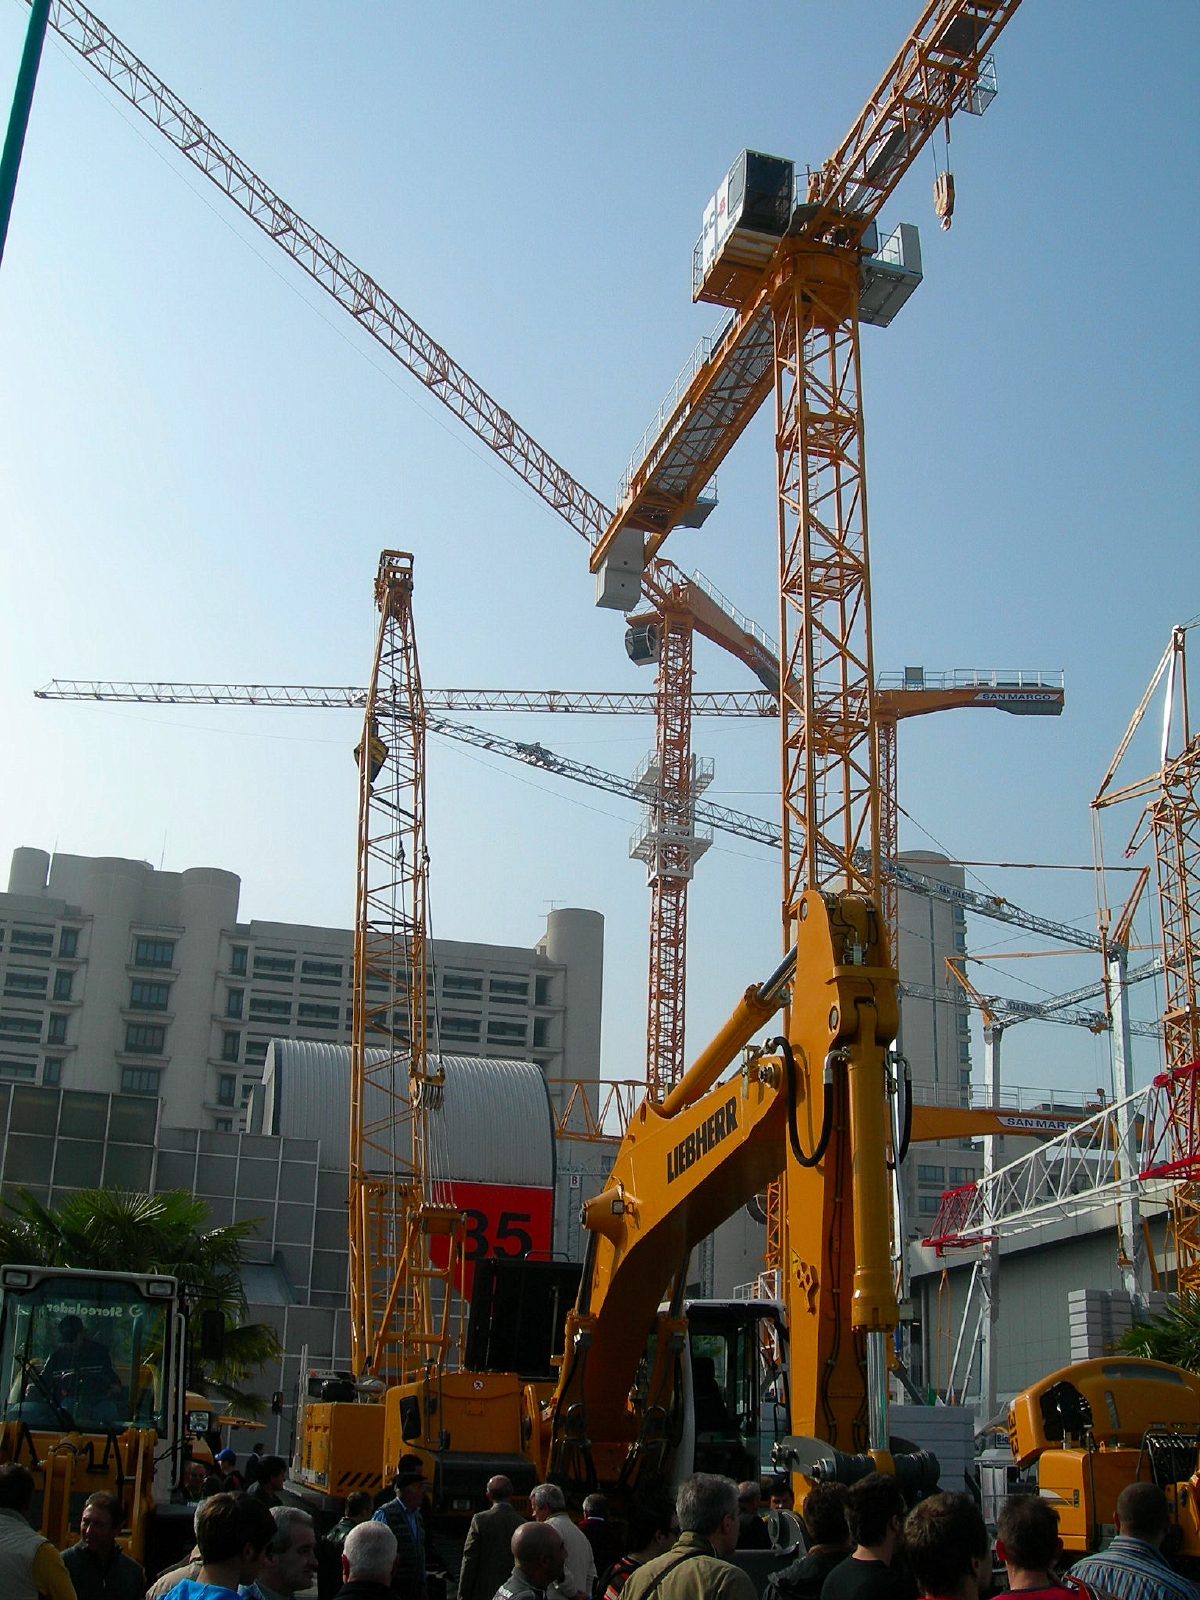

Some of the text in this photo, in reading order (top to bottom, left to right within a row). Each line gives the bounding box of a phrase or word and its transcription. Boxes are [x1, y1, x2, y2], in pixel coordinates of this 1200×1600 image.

[666, 1096, 738, 1185] LIEBHERR
[1007, 1117, 1080, 1130] SAN MARC
[457, 1209, 532, 1260] 35
